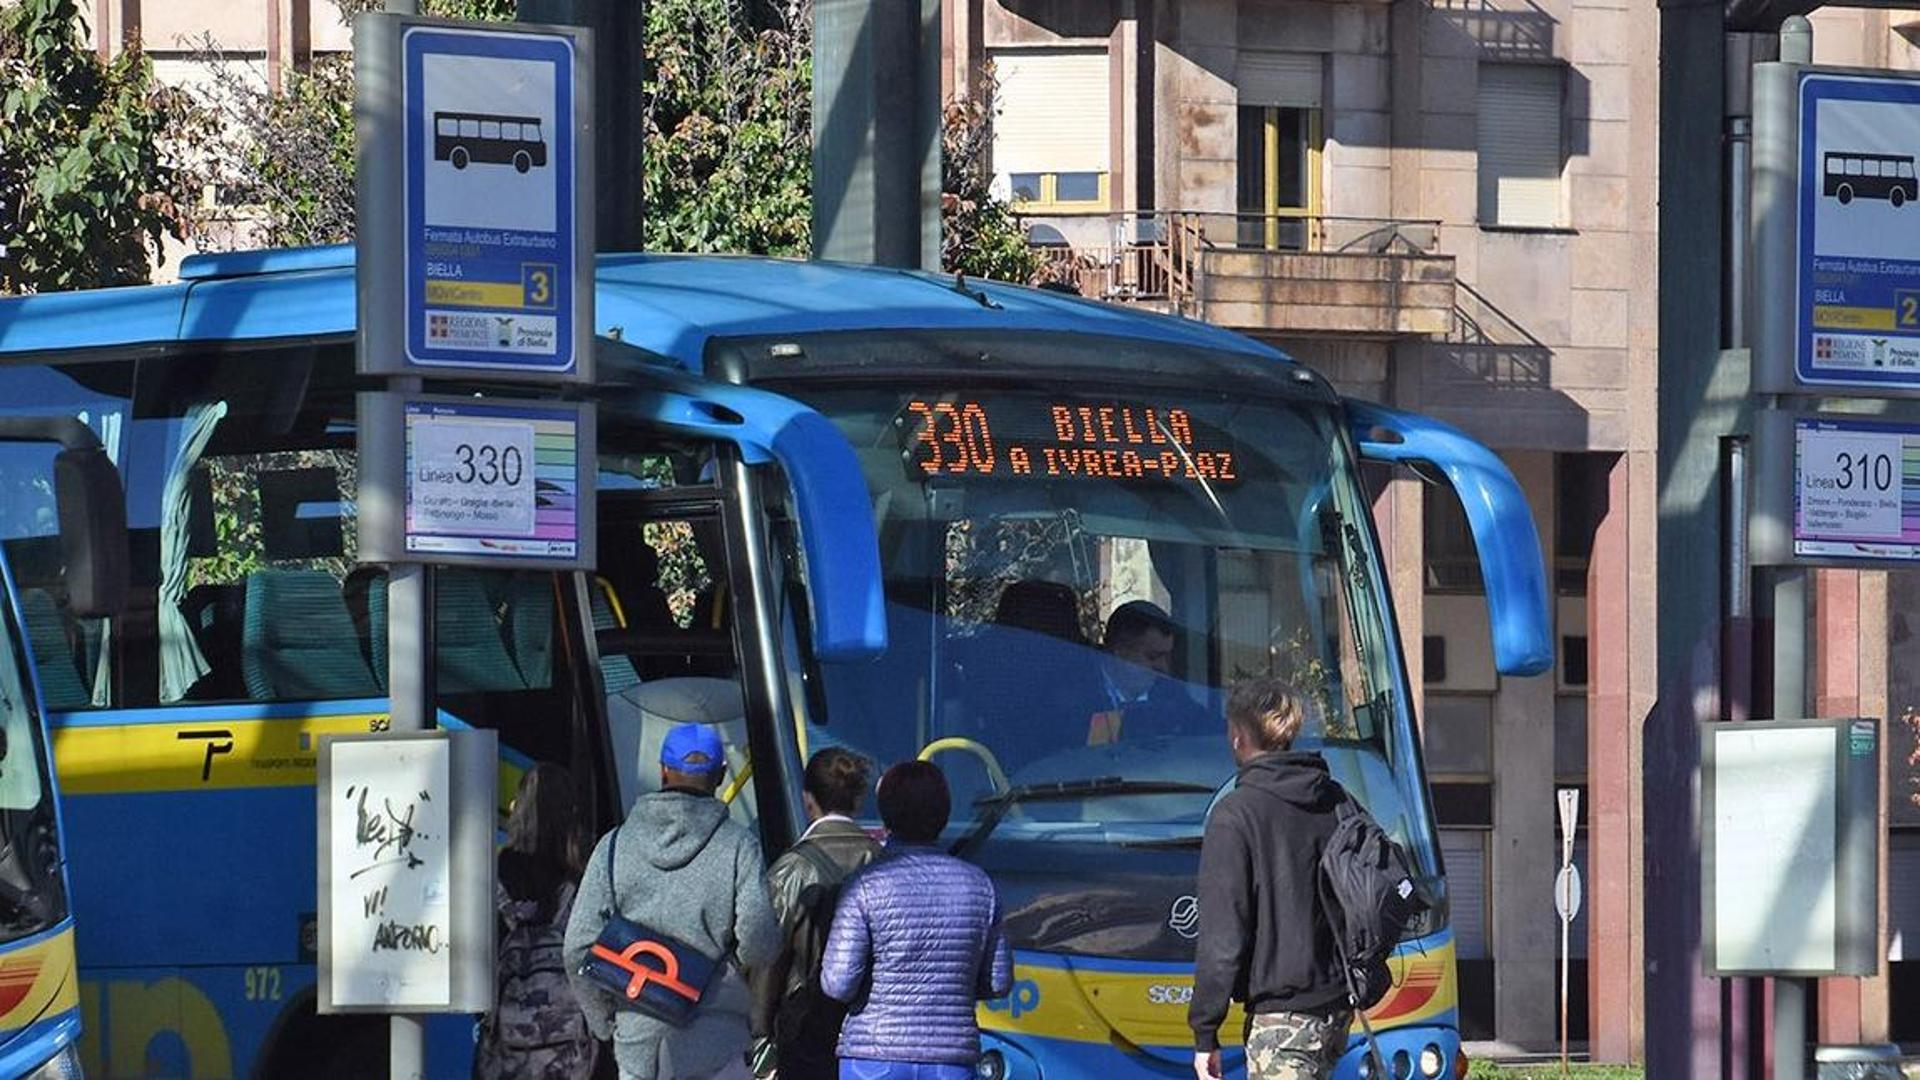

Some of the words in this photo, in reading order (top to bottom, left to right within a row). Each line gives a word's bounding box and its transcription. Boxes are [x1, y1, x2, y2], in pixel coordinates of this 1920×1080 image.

[424, 228, 462, 244] Fermata
[426, 262, 463, 278] BIELLA
[531, 271, 549, 302] 3
[1815, 289, 1846, 304] BIELLA
[1902, 297, 1918, 325] 2
[908, 401, 996, 474] 330
[1052, 405, 1193, 445] BIELLA
[419, 468, 454, 484] Linea
[455, 443, 522, 486] 330
[1009, 447, 1032, 475] A
[1043, 448, 1236, 480] IVREA-PIAZ
[1806, 474, 1835, 489] Linea
[1836, 452, 1892, 491] 310
[245, 966, 281, 1000] 972
